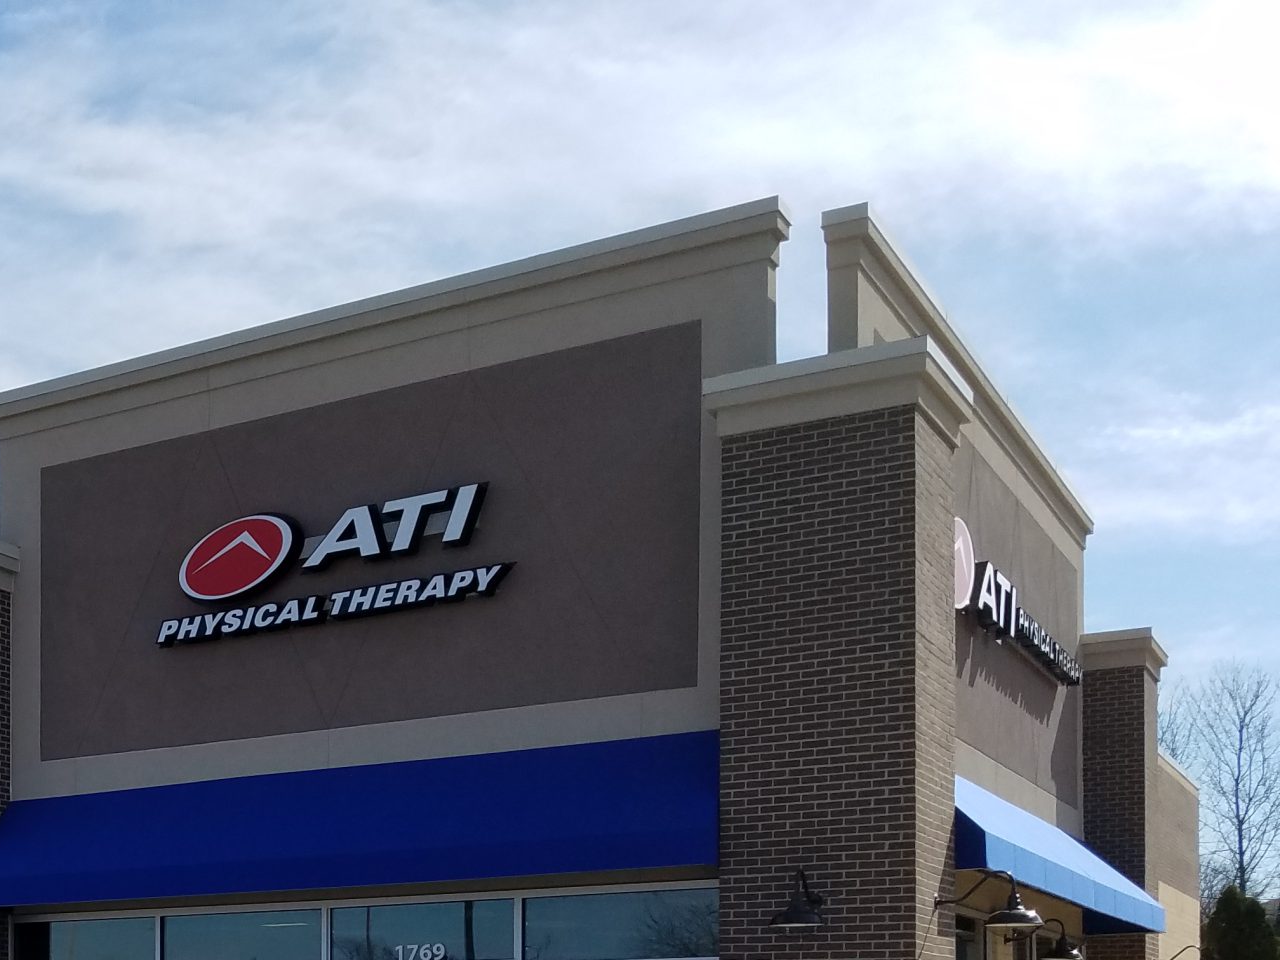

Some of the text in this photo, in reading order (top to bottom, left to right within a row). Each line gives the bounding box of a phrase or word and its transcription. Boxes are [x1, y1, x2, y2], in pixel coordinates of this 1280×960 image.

[302, 483, 480, 569] ATI
[157, 564, 503, 644] PHYSICAL THERAPY
[978, 561, 1017, 638] ATI
[1019, 608, 1055, 660] PHYSICAL
